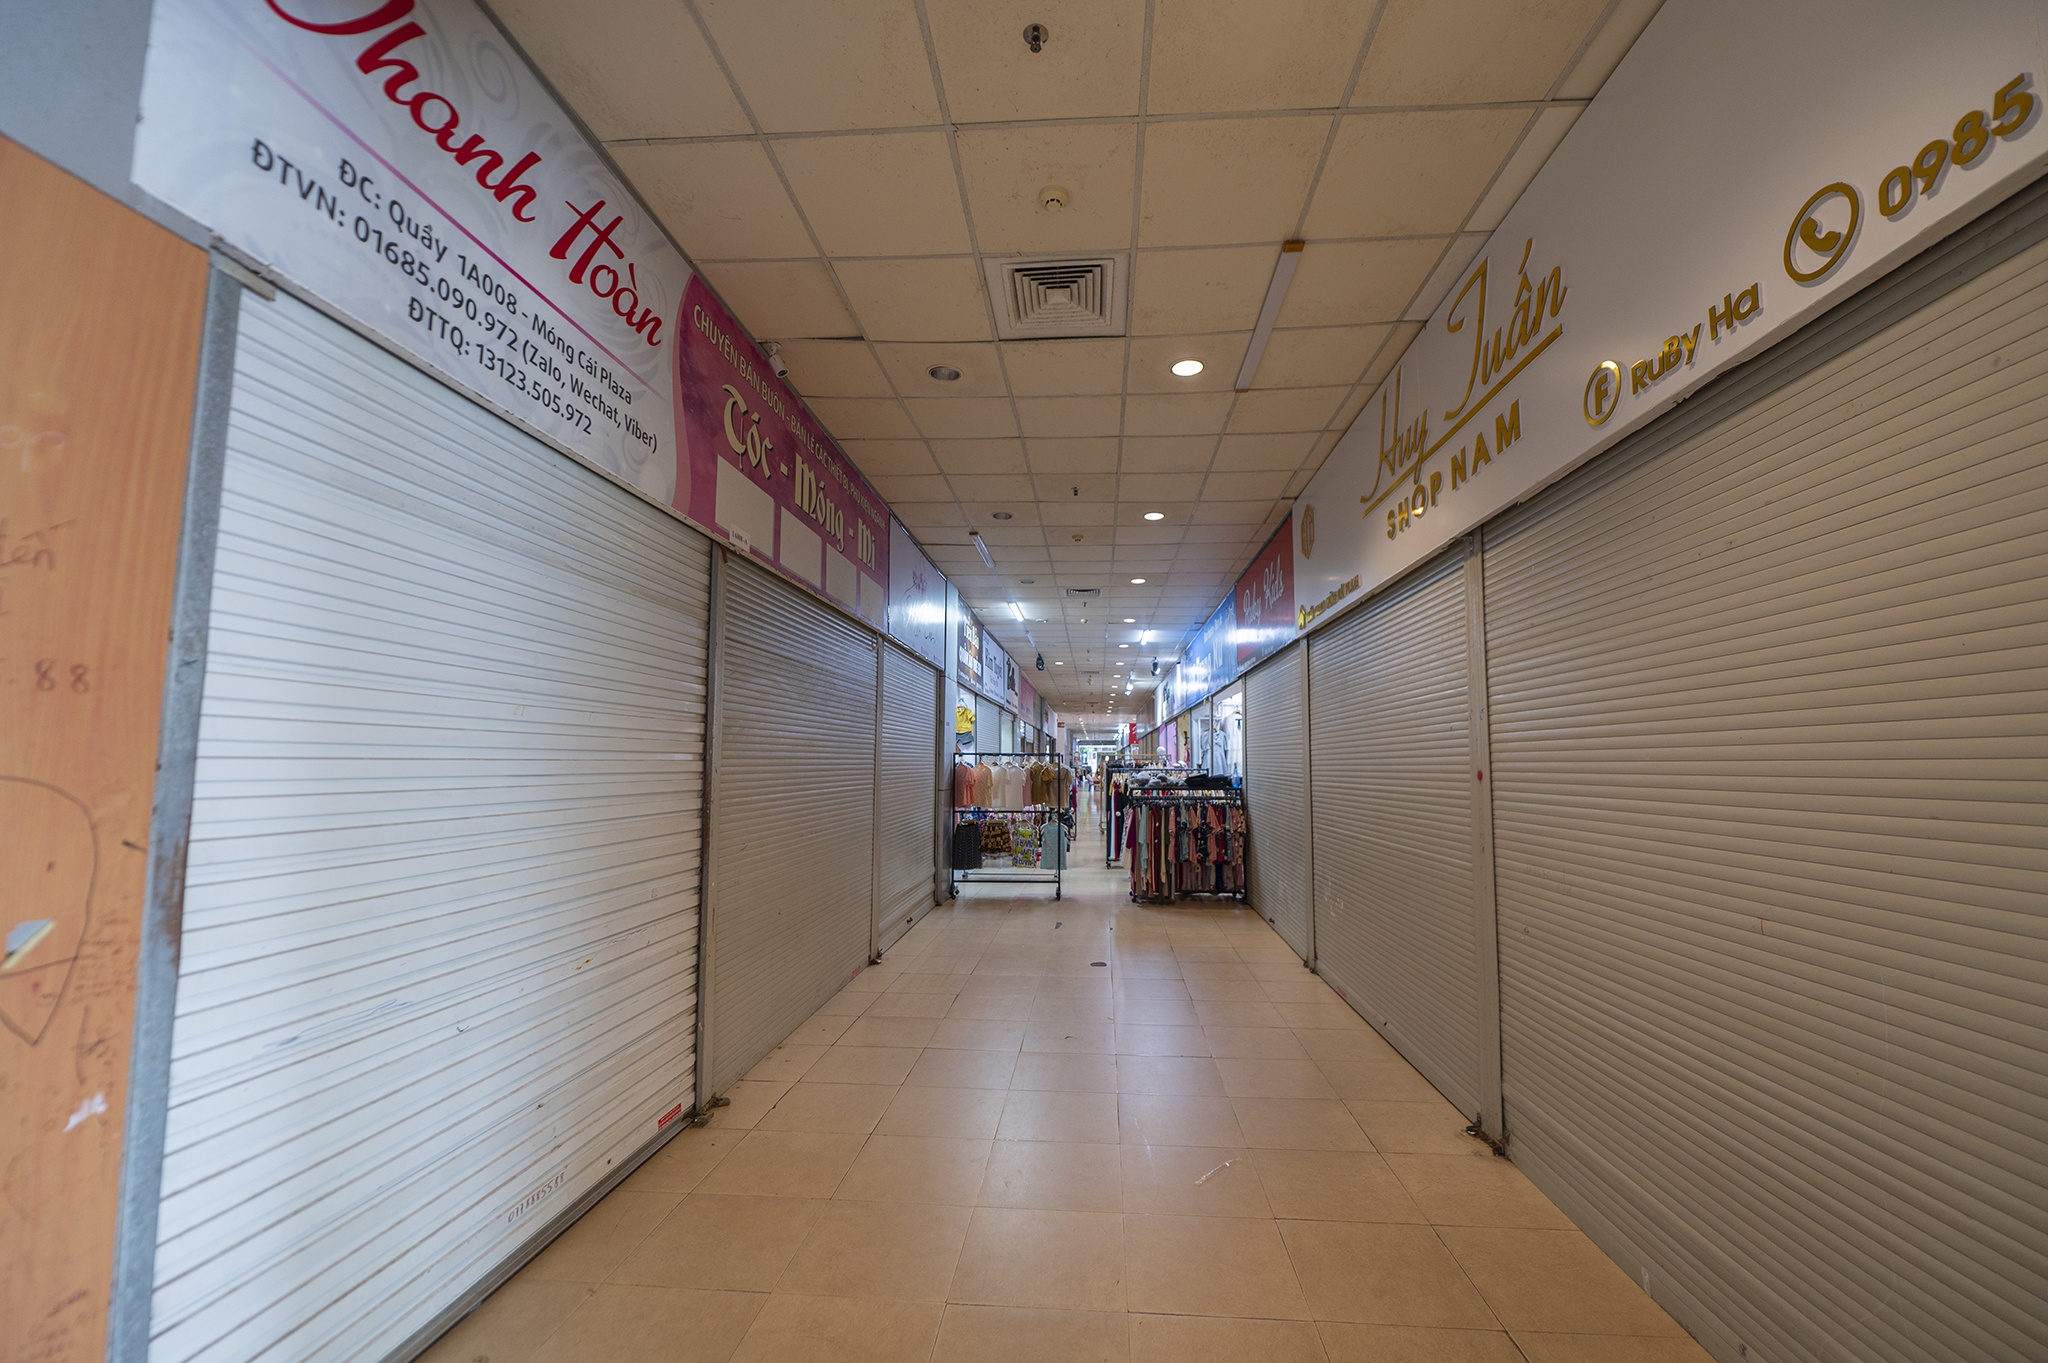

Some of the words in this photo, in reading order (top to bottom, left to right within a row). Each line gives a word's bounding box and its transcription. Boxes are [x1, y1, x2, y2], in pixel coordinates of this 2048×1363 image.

[1879, 72, 2036, 217] 0985
[252, 138, 346, 227] ĐTVN:
[354, 215, 518, 352] 01685.090.972
[523, 339, 567, 389] (Zalo,
[569, 373, 622, 428] Wechat,
[624, 414, 658, 453] Viber)
[338, 158, 381, 209] ĐC:
[389, 200, 448, 263] Quầy
[457, 254, 517, 315] 1A008
[532, 313, 574, 364] Móng
[578, 350, 597, 379] Cái
[600, 367, 632, 405] Plaza
[549, 200, 662, 346] Hoàn
[1708, 283, 1760, 341] Ha
[408, 296, 470, 355] ĐTTQ:
[475, 343, 592, 435] 13123.505.972
[694, 304, 738, 369] CHUYÊN
[739, 355, 760, 394] BÁN
[761, 381, 785, 421] BUÔN
[1360, 364, 1428, 504] Huy
[1443, 238, 1568, 421] Tuấn
[794, 453, 845, 552] Móng
[1386, 471, 1442, 540] SHOP
[1451, 398, 1523, 491] NAM
